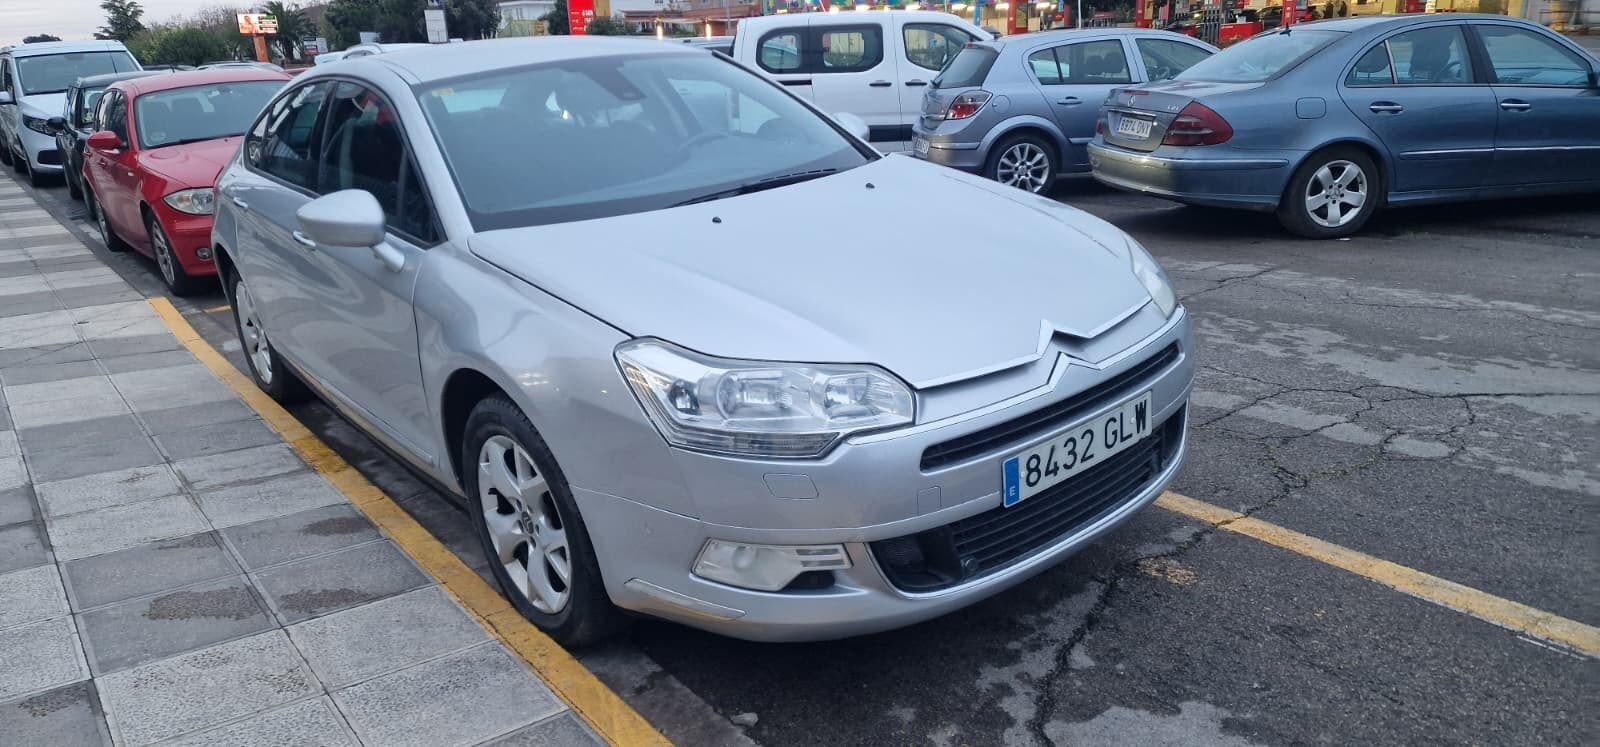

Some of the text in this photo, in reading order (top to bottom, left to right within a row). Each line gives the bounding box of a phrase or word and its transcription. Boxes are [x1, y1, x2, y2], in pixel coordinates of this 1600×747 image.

[1026, 399, 1148, 487] 8432 GLW
[1009, 485, 1016, 497] E
